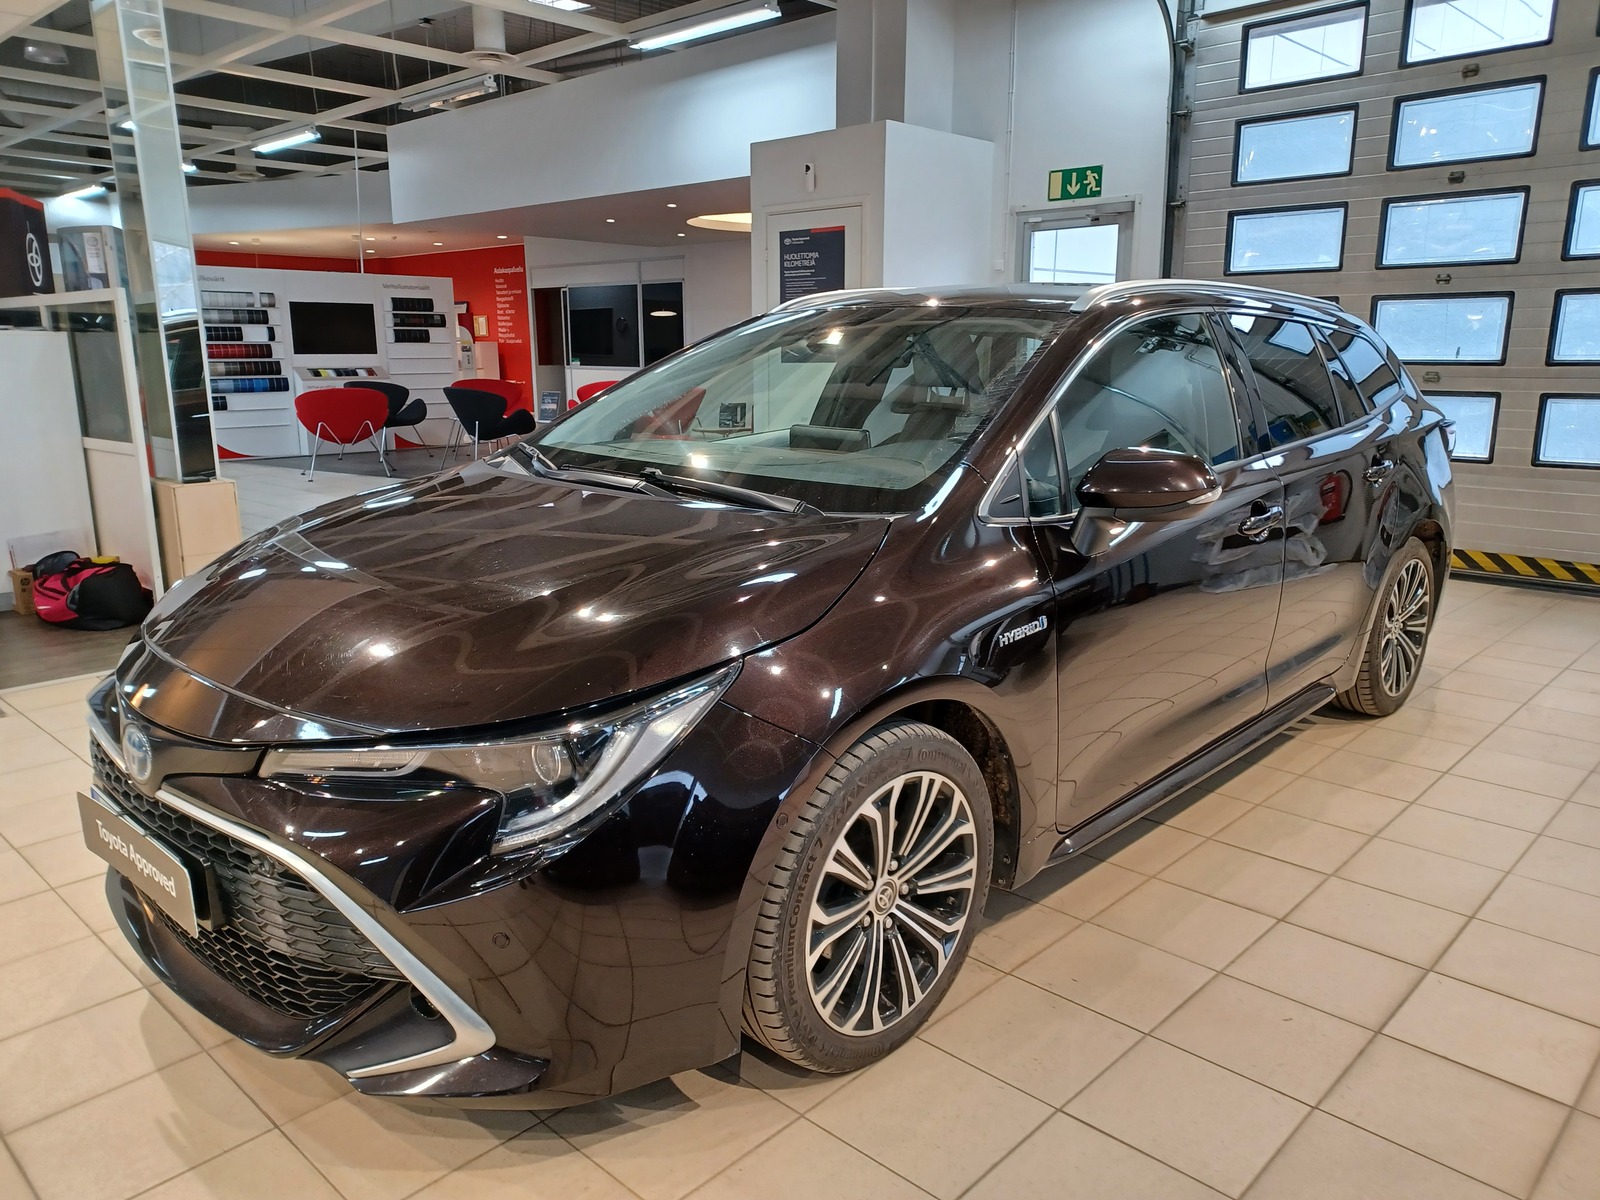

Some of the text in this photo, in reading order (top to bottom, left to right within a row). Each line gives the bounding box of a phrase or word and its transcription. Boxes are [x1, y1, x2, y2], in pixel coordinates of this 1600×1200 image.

[999, 618, 1044, 647] HYBRID
[96, 819, 176, 898] Toyota Approved
